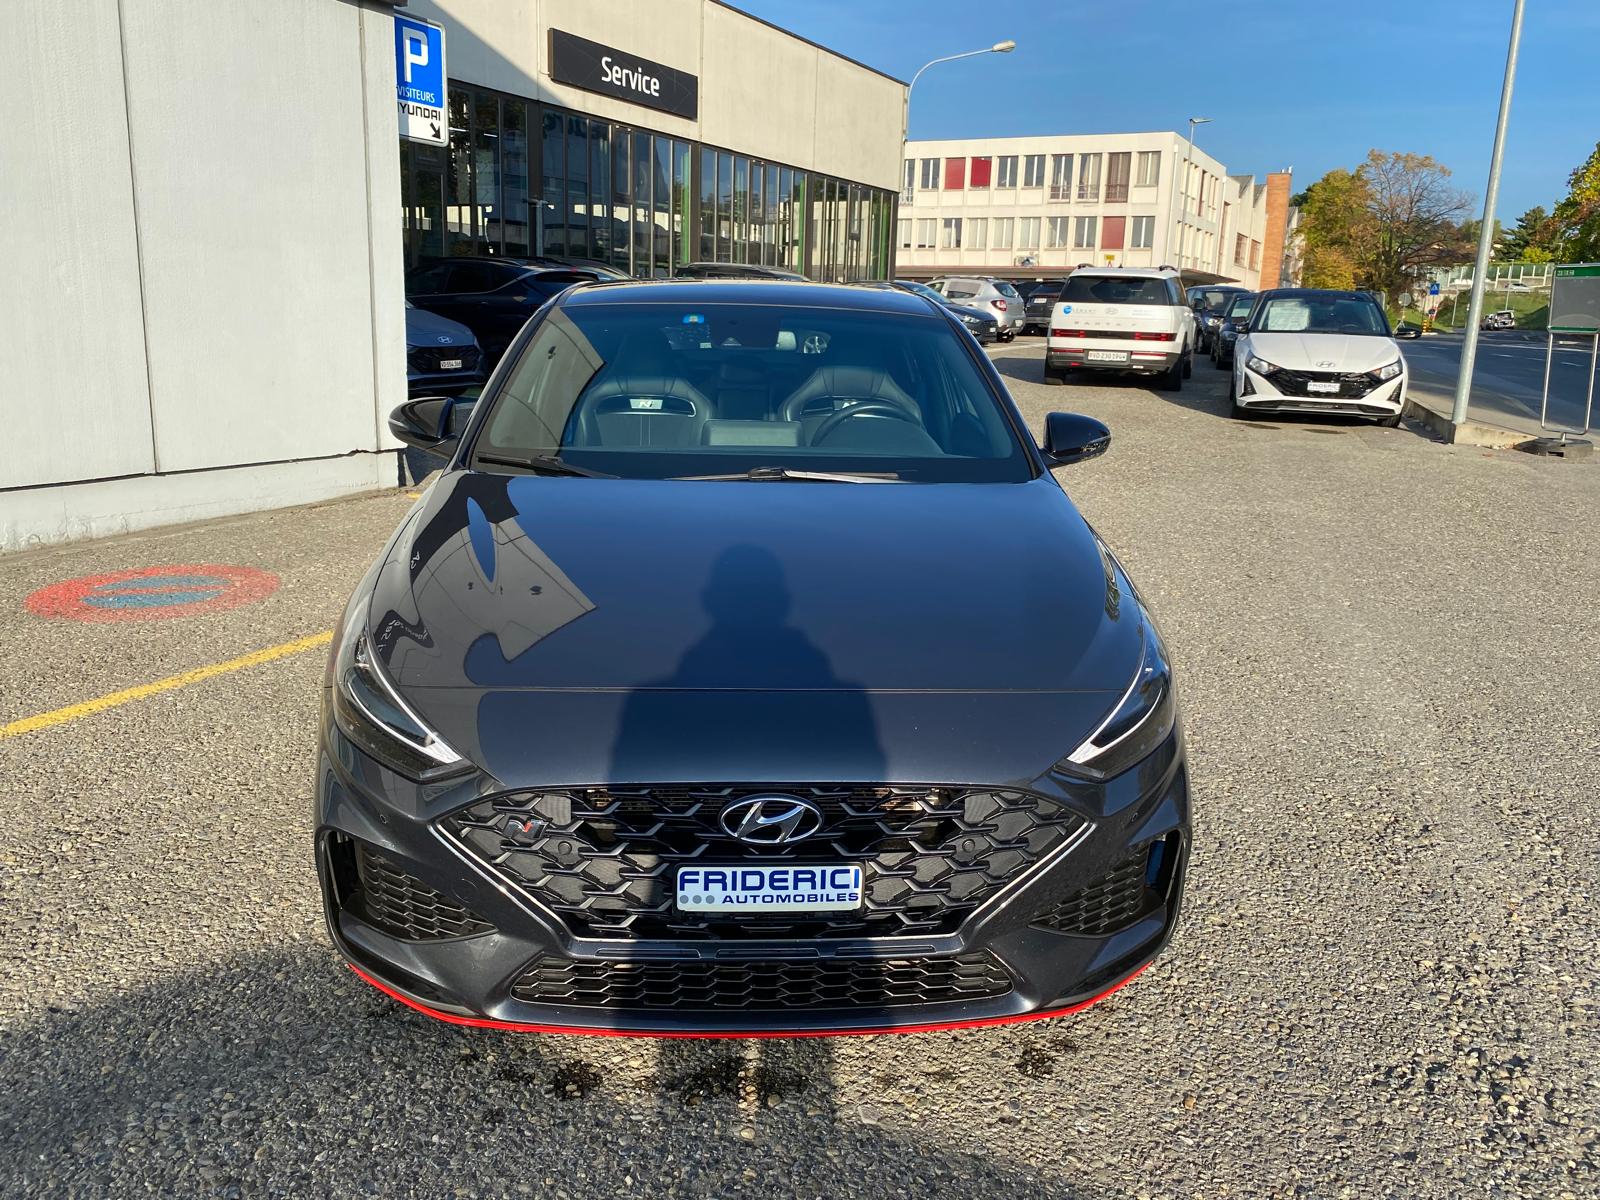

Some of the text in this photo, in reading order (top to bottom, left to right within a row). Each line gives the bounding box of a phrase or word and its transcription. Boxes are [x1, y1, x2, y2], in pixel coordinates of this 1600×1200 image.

[402, 26, 429, 83] P
[601, 56, 660, 97] Service
[397, 86, 435, 103] VISITEURS
[679, 868, 860, 892] FRIDERICI
[721, 892, 860, 904] AUTOMOBILES
